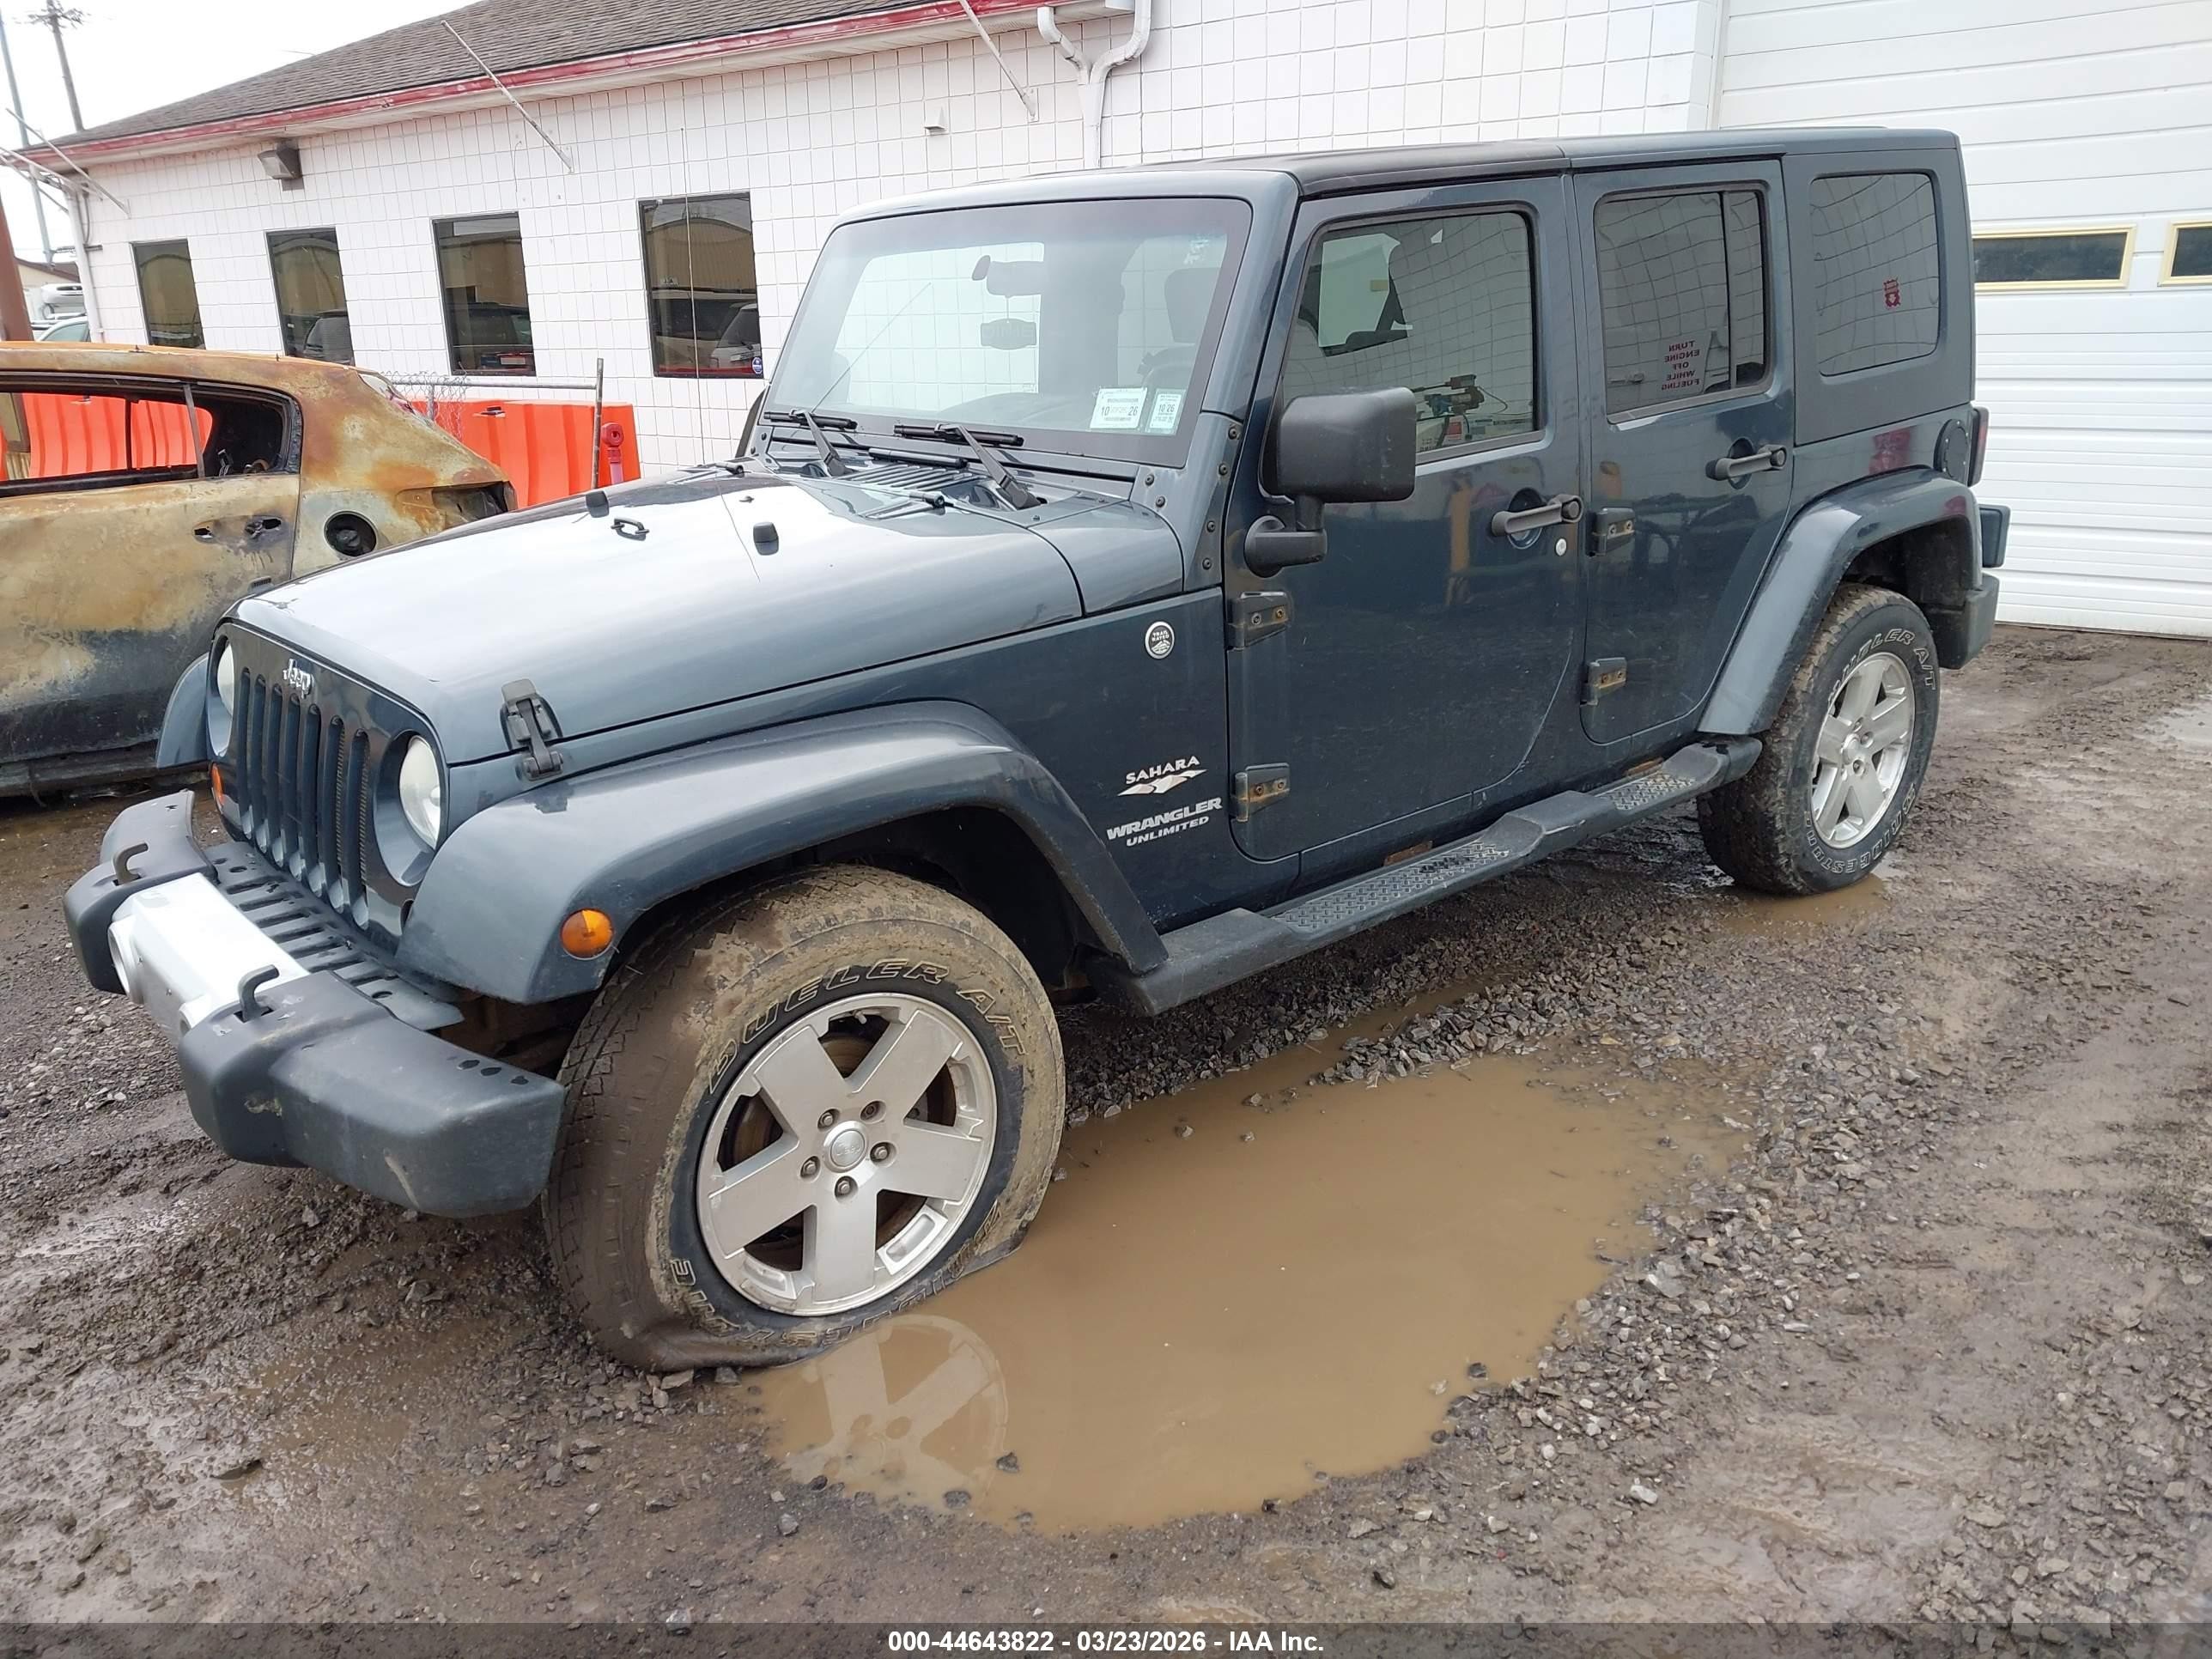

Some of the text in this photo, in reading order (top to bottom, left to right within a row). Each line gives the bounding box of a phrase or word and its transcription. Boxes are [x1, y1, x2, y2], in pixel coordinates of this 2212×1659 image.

[1102, 406, 1110, 416] 10
[1128, 406, 1138, 416] 26
[283, 659, 315, 699] Jeep
[1126, 756, 1200, 784] SAHARA
[1107, 797, 1223, 840] WRANGLER
[1126, 816, 1210, 847] UNLIMITED
[709, 958, 1029, 1094] DUELER A/T
